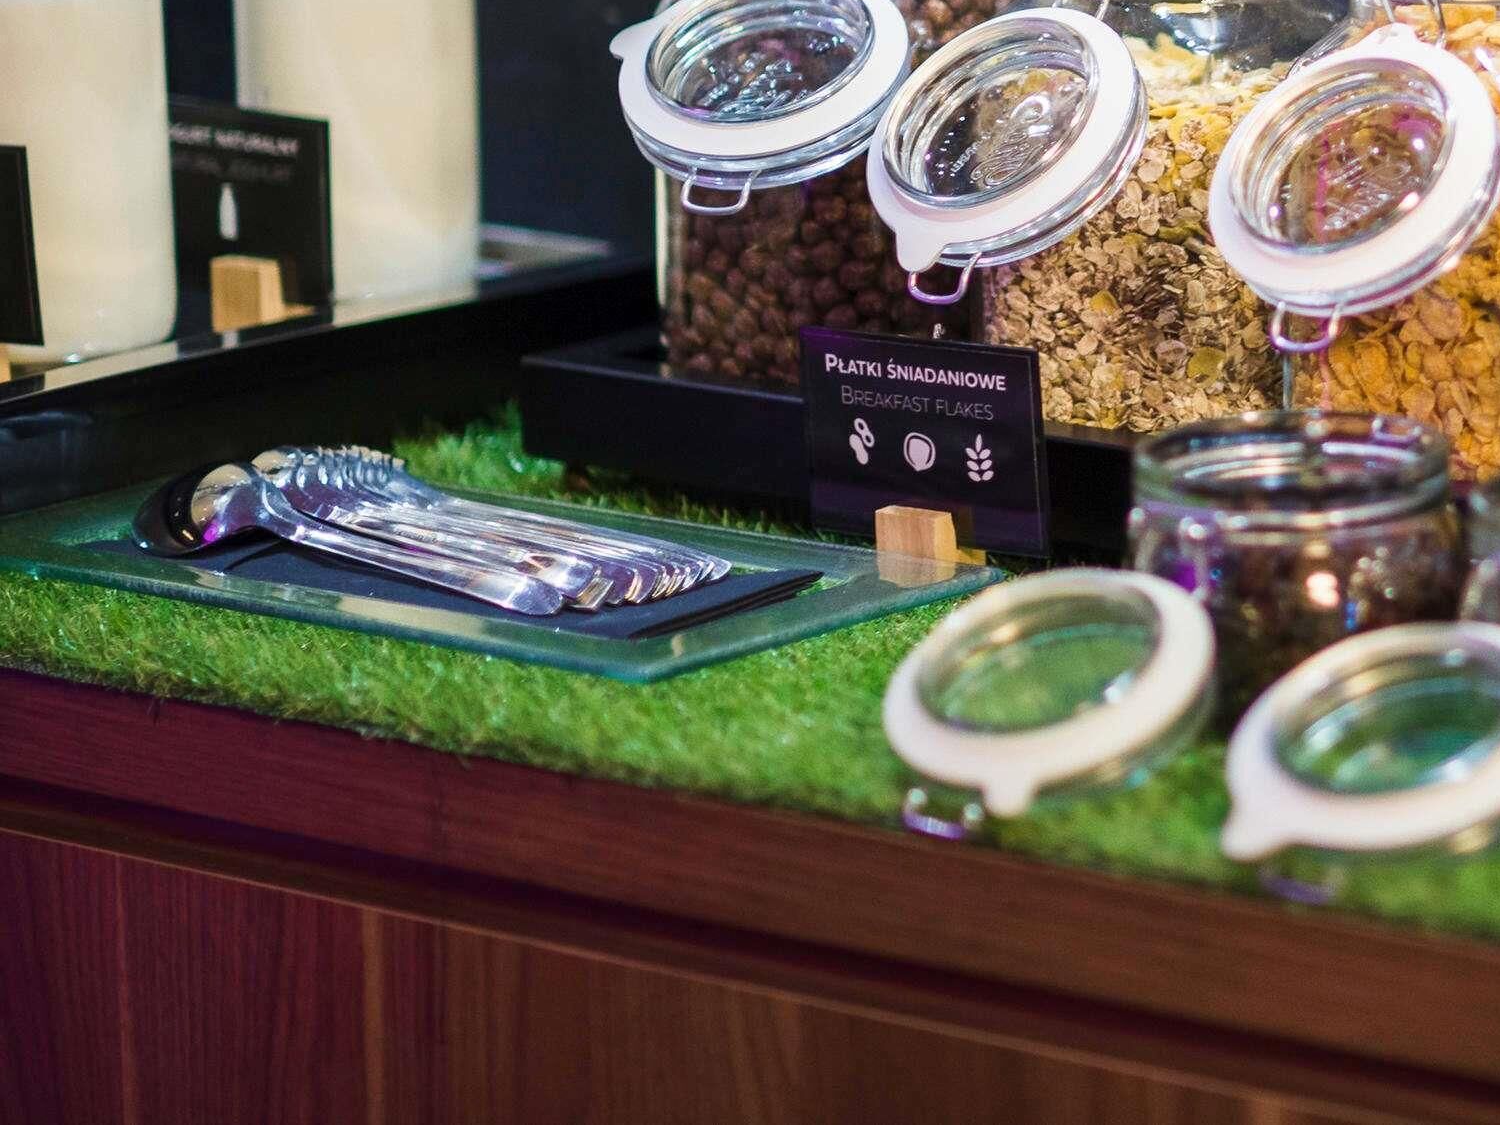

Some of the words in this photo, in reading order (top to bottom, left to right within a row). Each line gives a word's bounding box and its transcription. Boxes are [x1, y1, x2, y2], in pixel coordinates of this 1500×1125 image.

[824, 353, 882, 378] PŁATKI
[886, 358, 1007, 391] ŚNIADANIOWE
[840, 385, 931, 413] BREAKFAST
[935, 399, 994, 421] FLAKES
